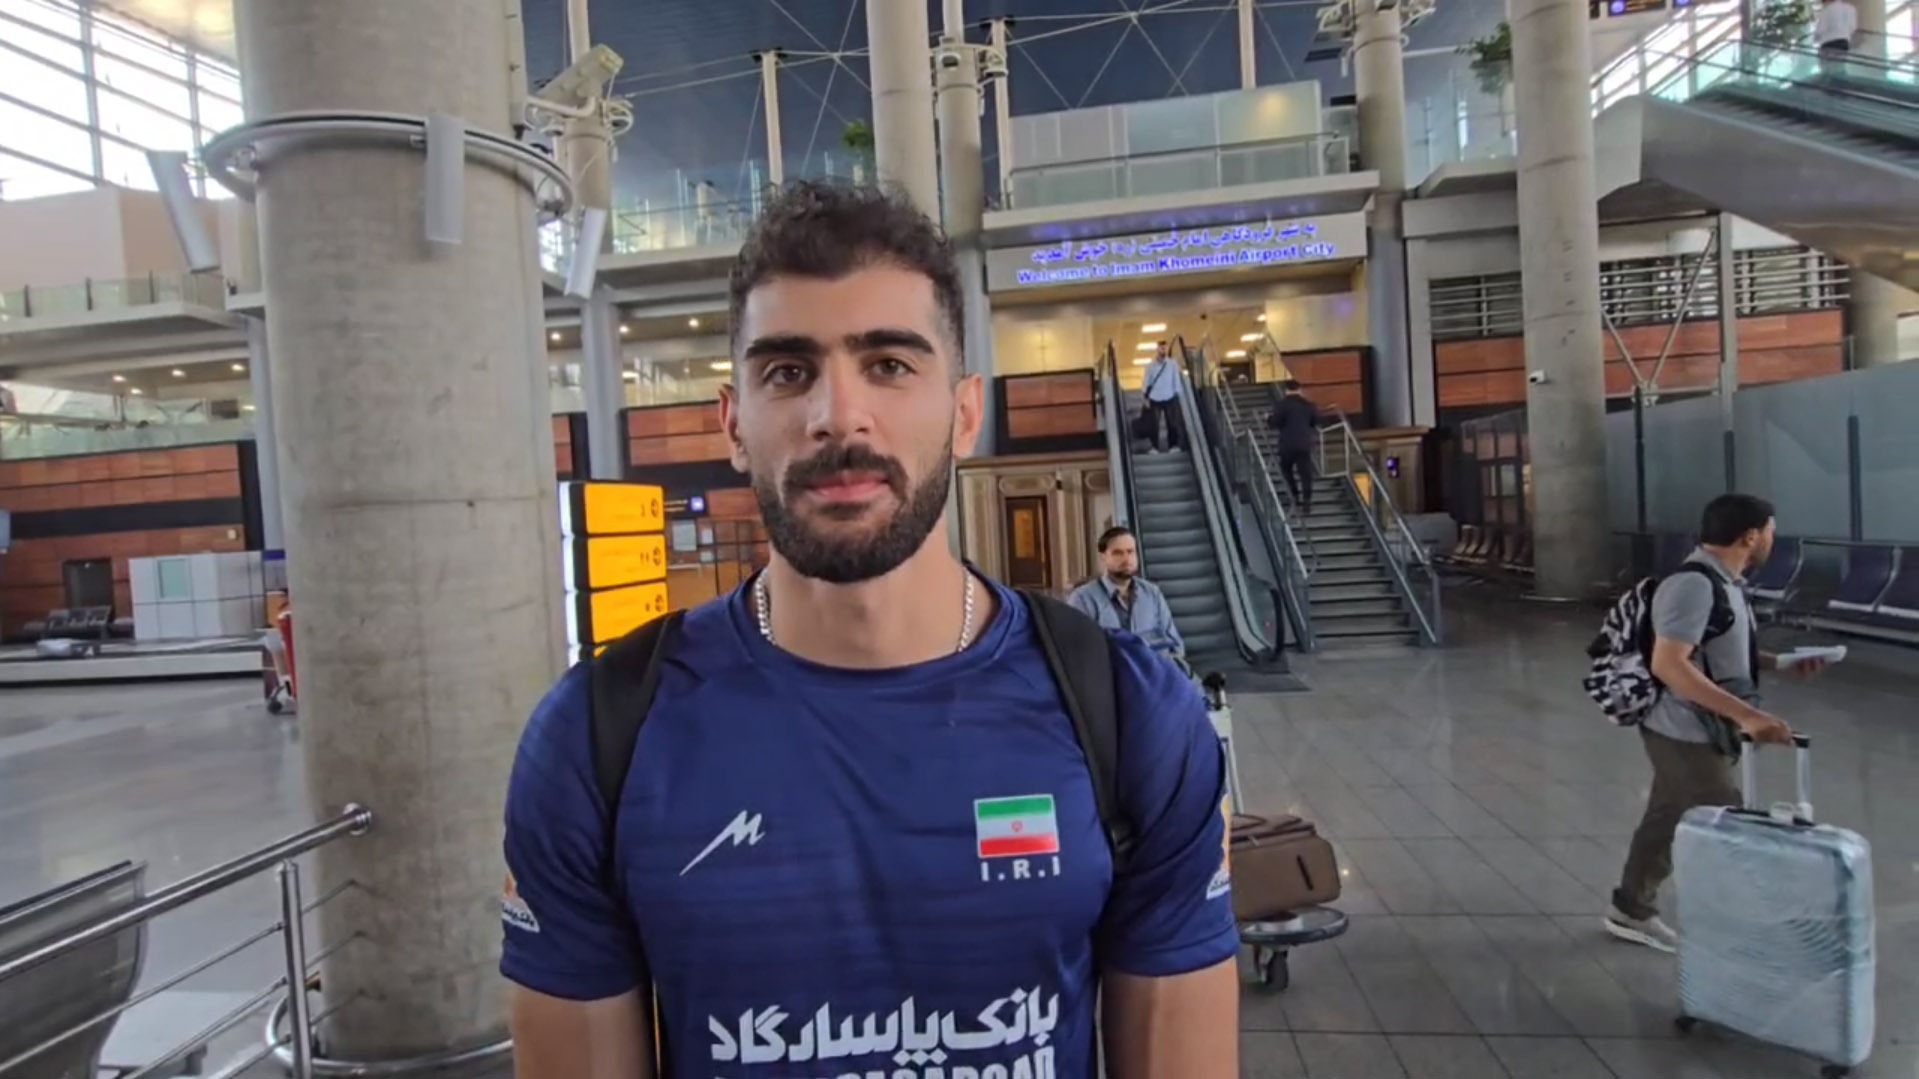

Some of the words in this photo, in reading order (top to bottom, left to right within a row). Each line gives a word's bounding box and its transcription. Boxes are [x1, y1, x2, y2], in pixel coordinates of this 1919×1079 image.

[1017, 266, 1089, 284] Welcome
[1091, 263, 1108, 278] to
[1111, 260, 1155, 276] Imam
[1158, 253, 1236, 271] Khomeini
[1238, 246, 1298, 265] Airport
[1301, 242, 1335, 258] City
[709, 996, 947, 1065] پاسارگاد
[939, 985, 1059, 1050] بانک
